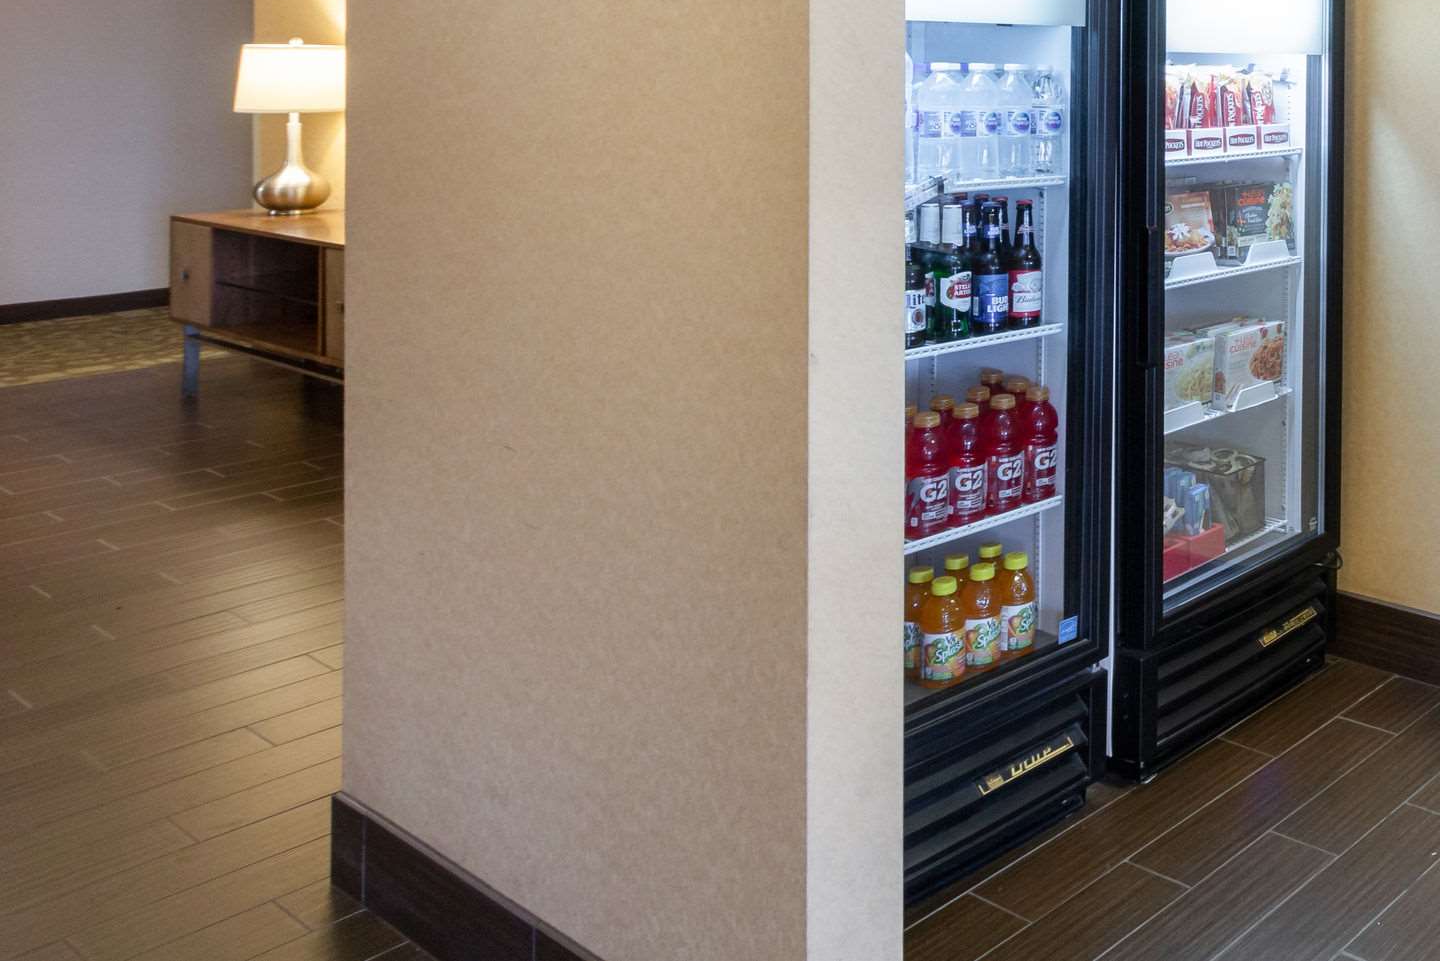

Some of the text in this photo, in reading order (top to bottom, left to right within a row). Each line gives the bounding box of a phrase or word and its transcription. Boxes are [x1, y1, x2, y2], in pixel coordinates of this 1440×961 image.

[996, 458, 1024, 481] G2
[1033, 449, 1057, 471] G2
[919, 479, 948, 503] G2
[954, 469, 984, 492] G2
